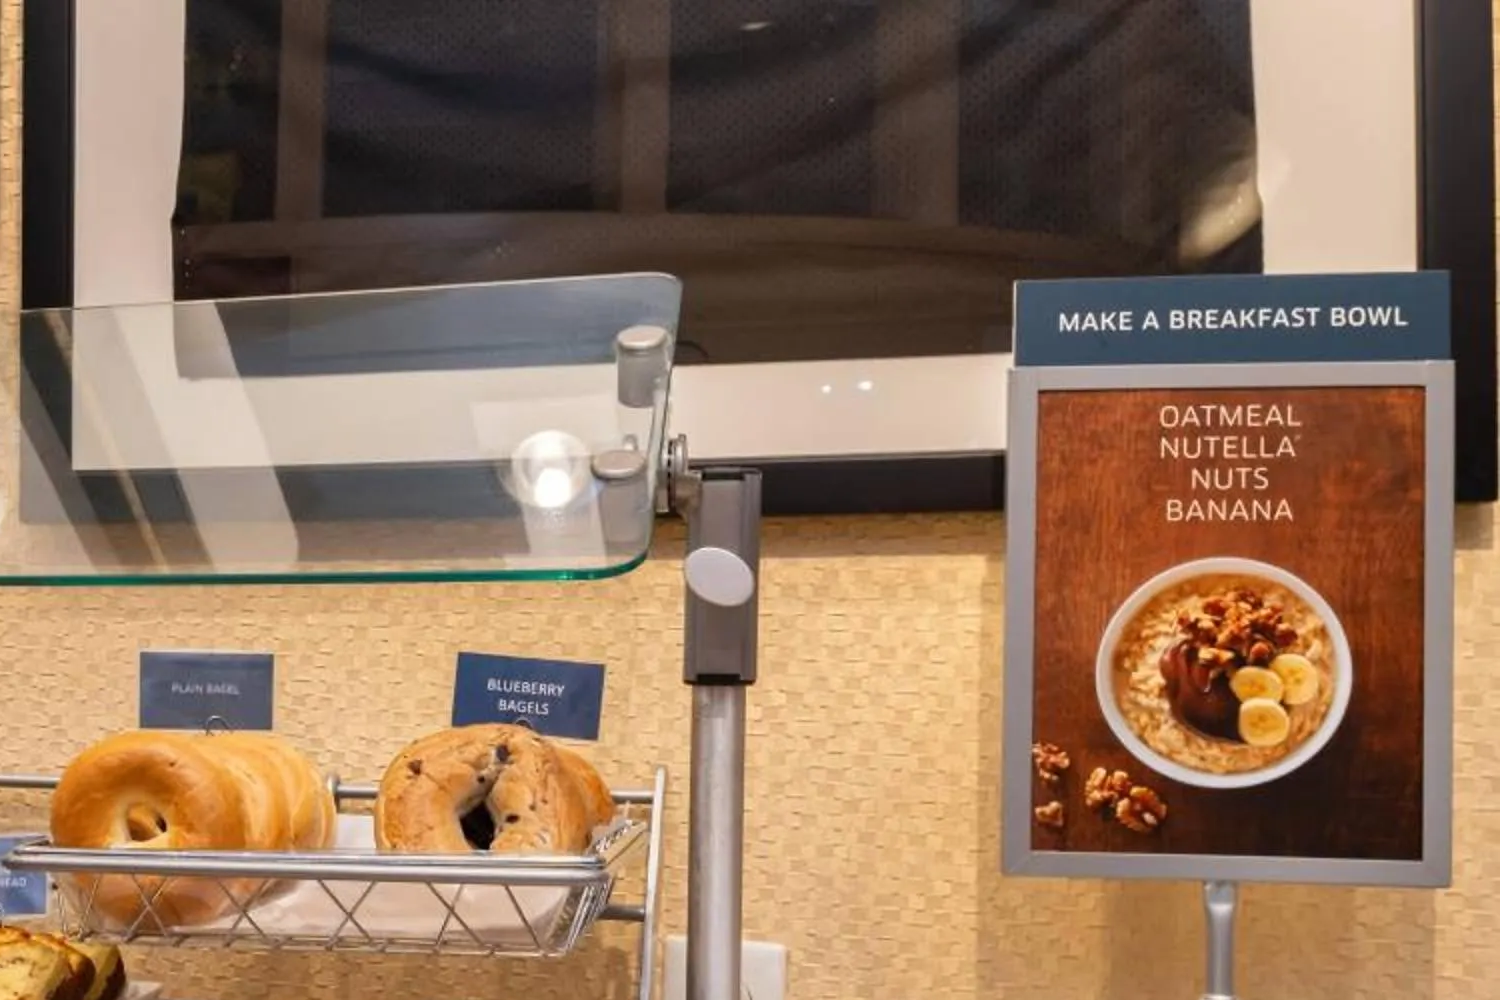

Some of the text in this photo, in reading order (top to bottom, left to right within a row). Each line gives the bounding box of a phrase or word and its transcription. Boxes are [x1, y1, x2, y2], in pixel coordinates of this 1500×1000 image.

[1058, 306, 1409, 333] MAKE A BREAKFAST BOWL
[1159, 404, 1302, 428] OATMEAL
[1191, 467, 1269, 490] NUTS
[1166, 498, 1294, 522] BANANA
[486, 677, 566, 697] BLUEBERRY
[498, 698, 550, 715] BAGELS
